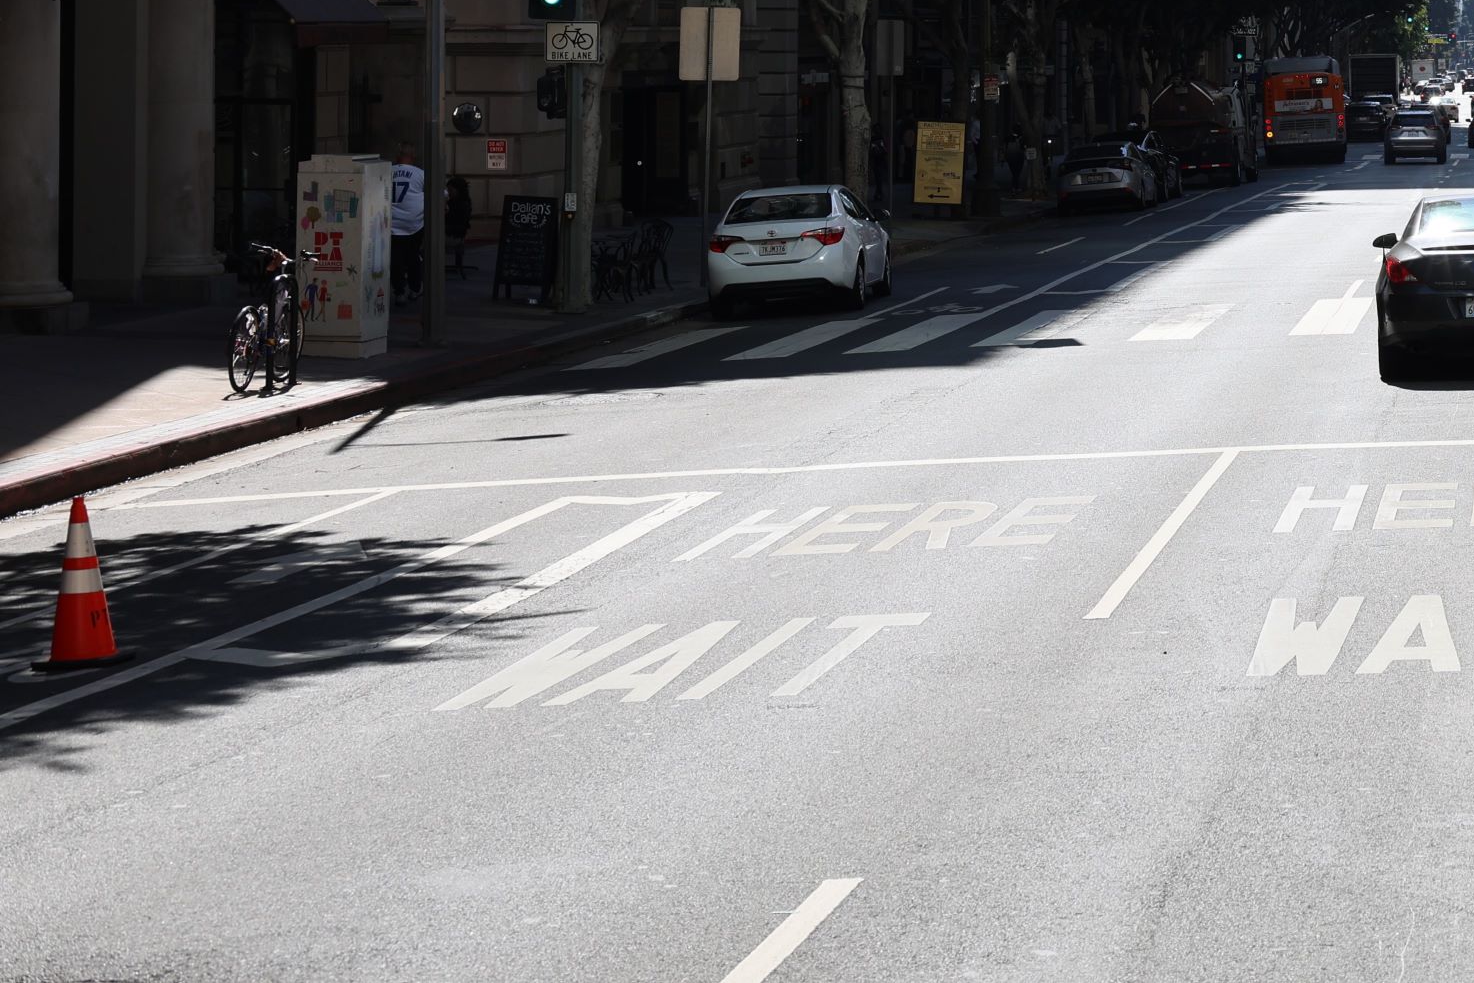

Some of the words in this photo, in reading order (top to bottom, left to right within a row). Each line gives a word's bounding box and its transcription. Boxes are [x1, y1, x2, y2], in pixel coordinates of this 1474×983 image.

[552, 51, 568, 59] BIKE
[573, 51, 593, 59] LANE
[672, 495, 1097, 562] HERE
[432, 613, 932, 711] WAIT
